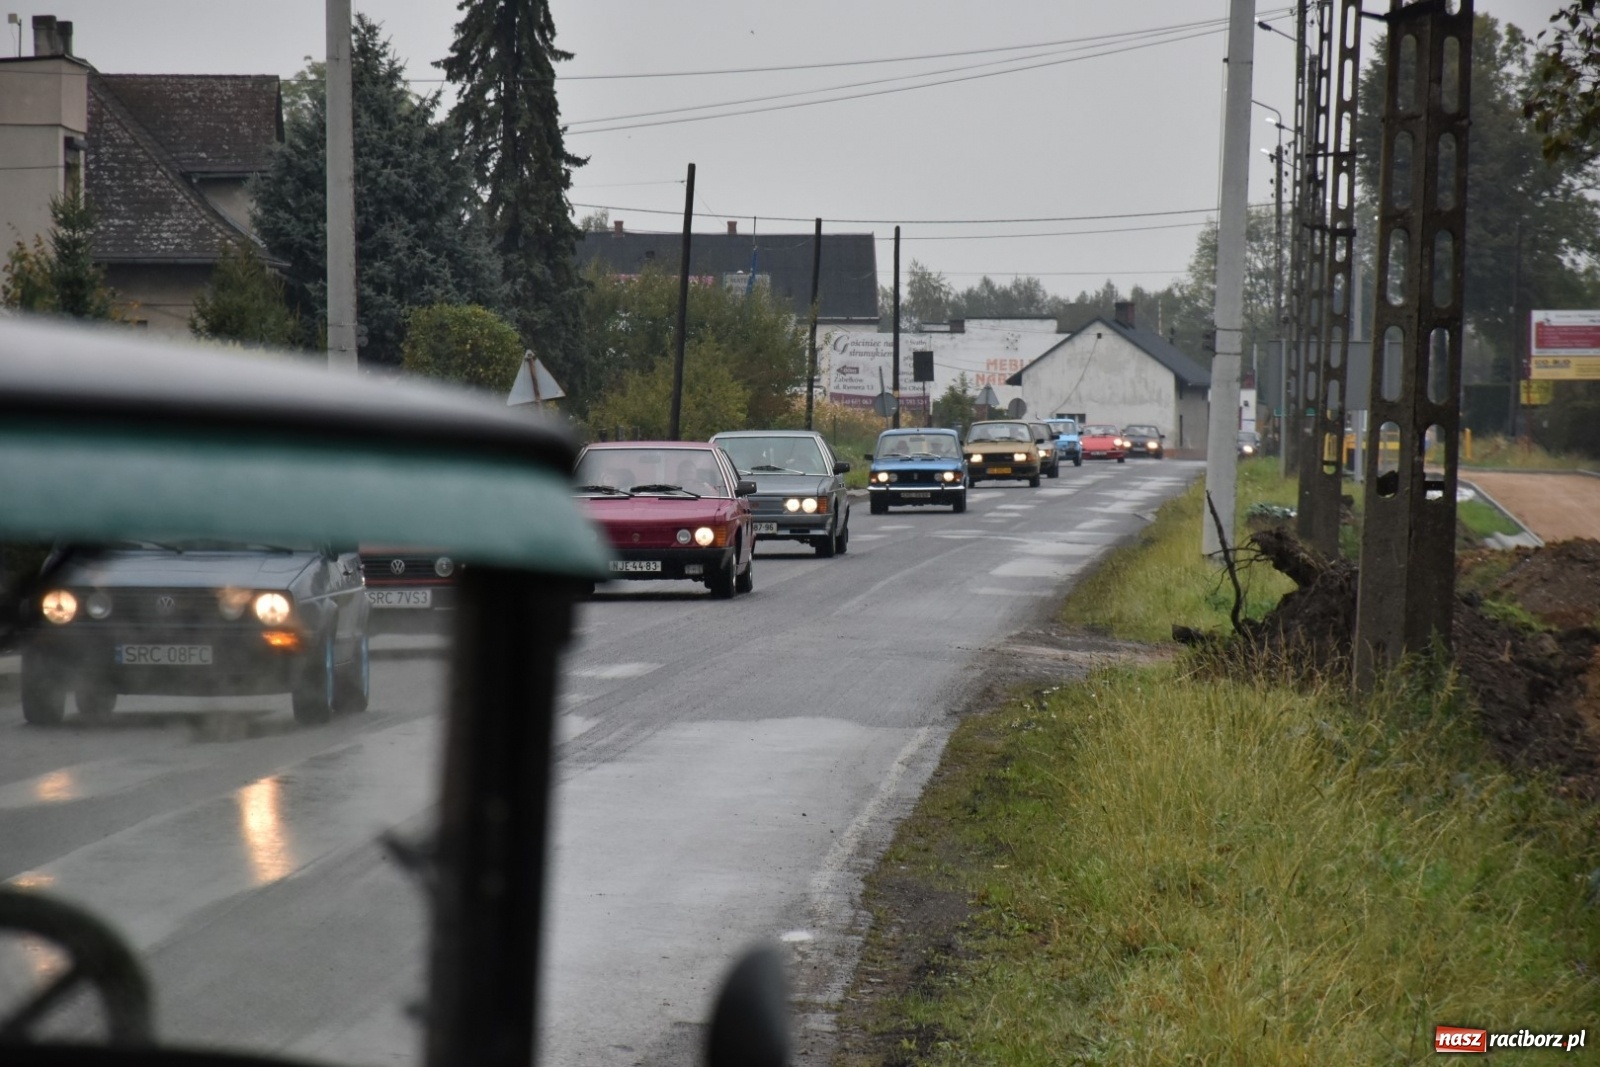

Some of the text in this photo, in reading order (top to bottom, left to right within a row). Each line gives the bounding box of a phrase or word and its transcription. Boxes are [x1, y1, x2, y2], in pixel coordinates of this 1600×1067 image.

[368, 591, 428, 605] SRC 7VS3
[125, 646, 161, 663] SRC
